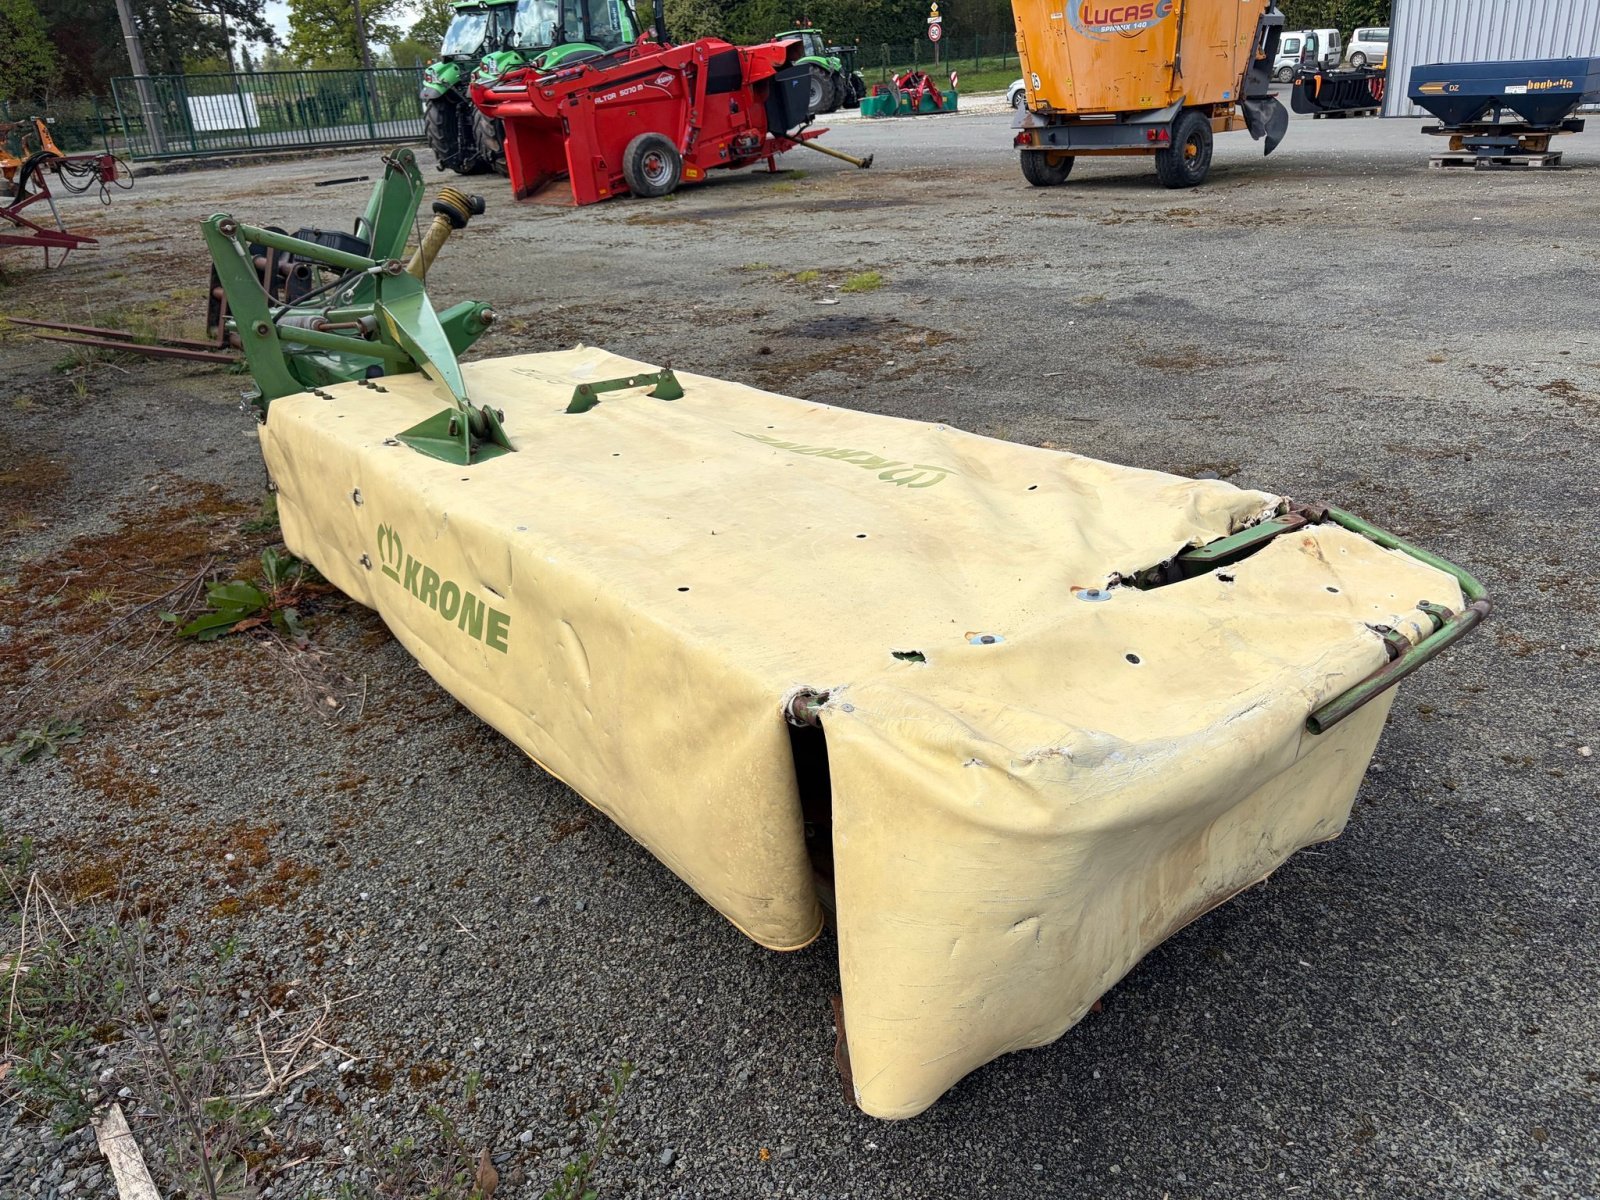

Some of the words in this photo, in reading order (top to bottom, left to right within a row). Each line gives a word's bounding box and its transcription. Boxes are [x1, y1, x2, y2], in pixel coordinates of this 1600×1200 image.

[1083, 3, 1154, 24] LUCAS
[1133, 21, 1147, 30] 140
[594, 92, 617, 104] ALTOR
[619, 86, 637, 97] 5070
[1449, 84, 1460, 92] DZ
[403, 553, 511, 655] KRONE
